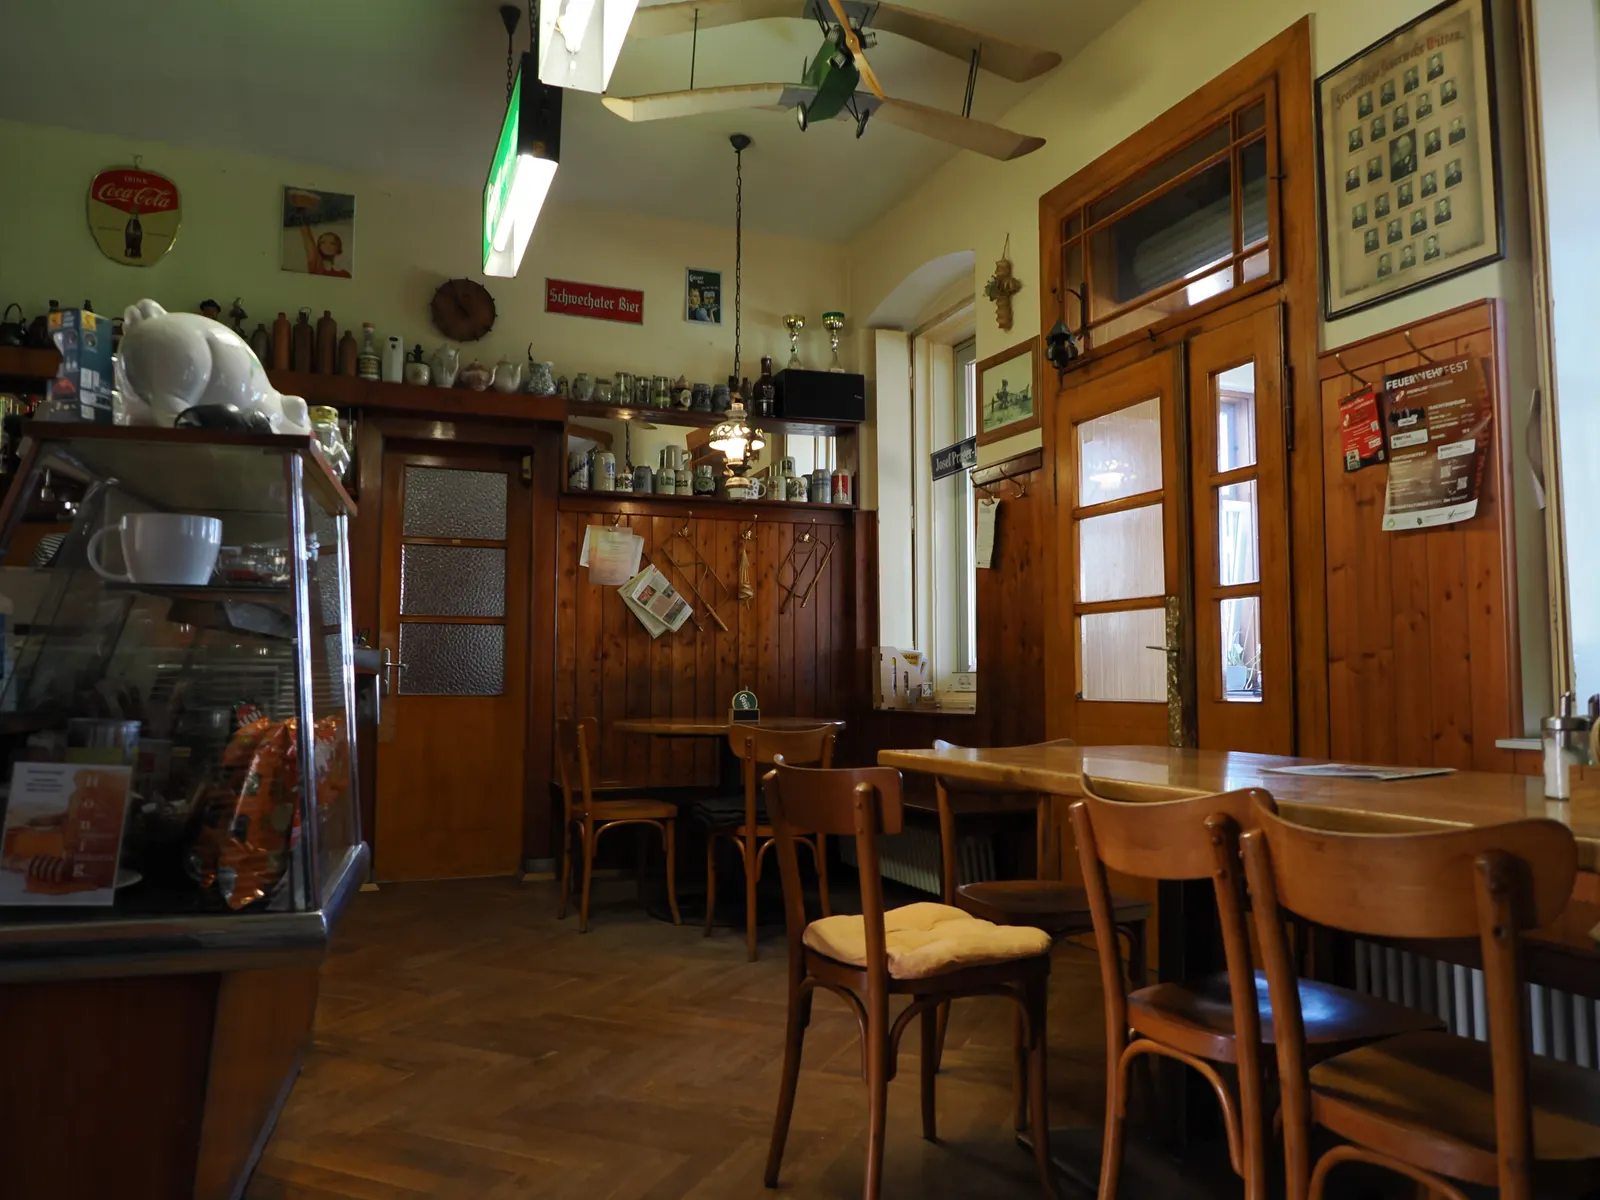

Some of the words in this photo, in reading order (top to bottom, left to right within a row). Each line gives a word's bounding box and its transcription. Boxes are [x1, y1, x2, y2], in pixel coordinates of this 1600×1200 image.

[549, 287, 615, 310] Schwechater
[618, 296, 640, 313] Bier
[1386, 360, 1469, 391] FEUERWEHRFEST
